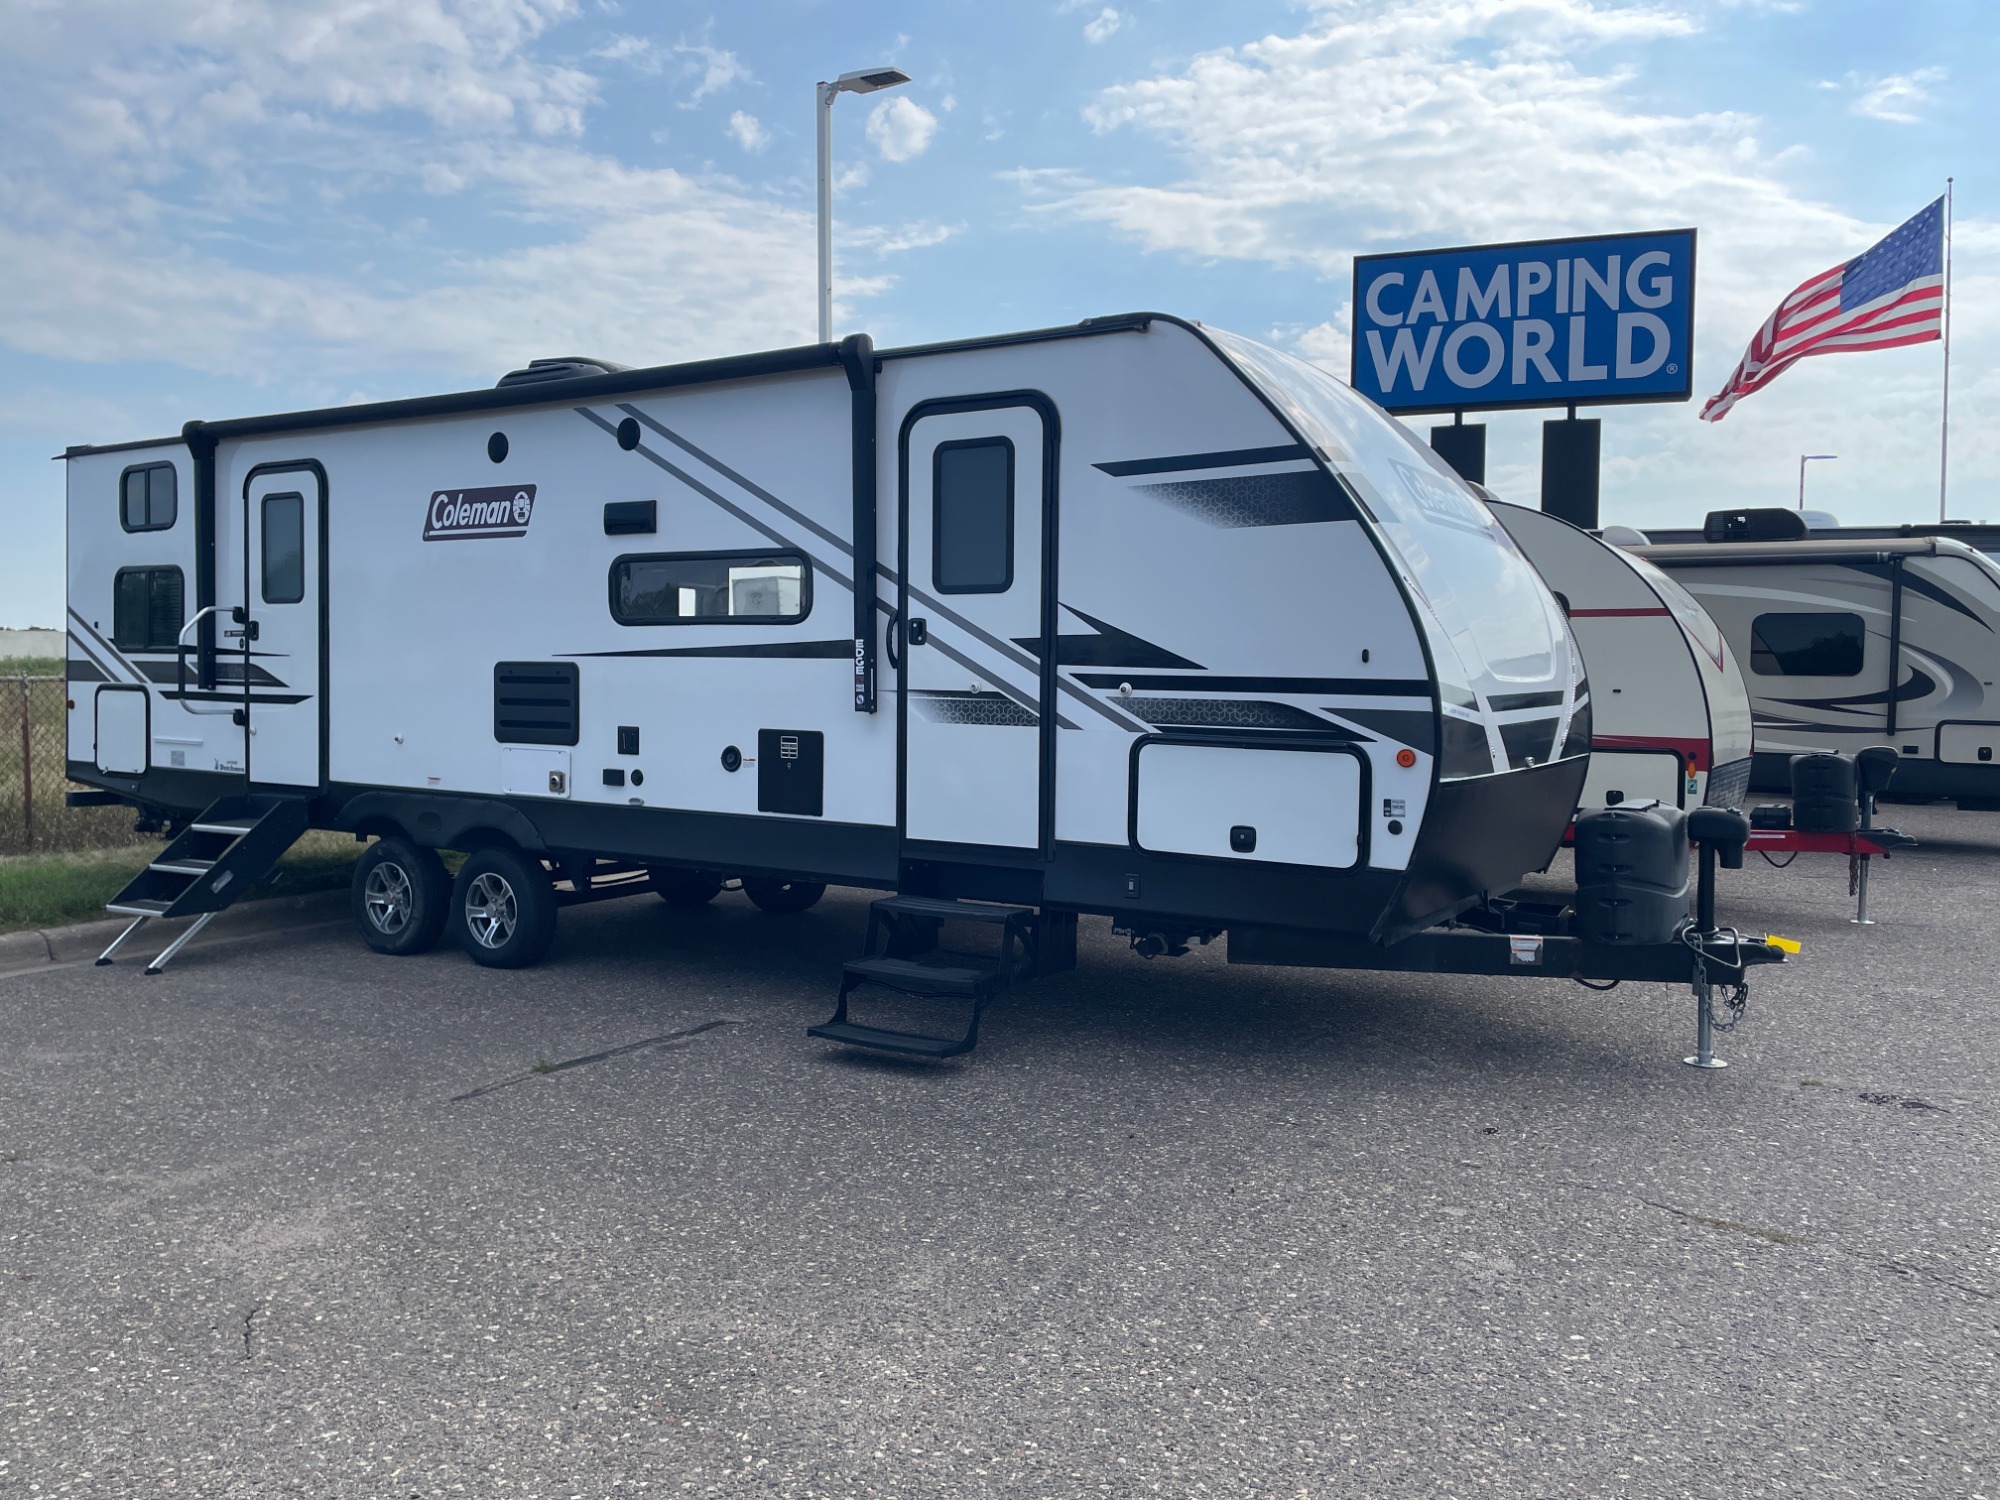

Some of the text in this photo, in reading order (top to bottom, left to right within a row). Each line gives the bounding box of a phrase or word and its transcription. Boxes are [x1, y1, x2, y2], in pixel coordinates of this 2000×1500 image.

[1365, 250, 1673, 328] CAMPING
[1365, 311, 1671, 393] WORLD
[431, 493, 511, 530] Coleman
[855, 638, 865, 675] EDGE
